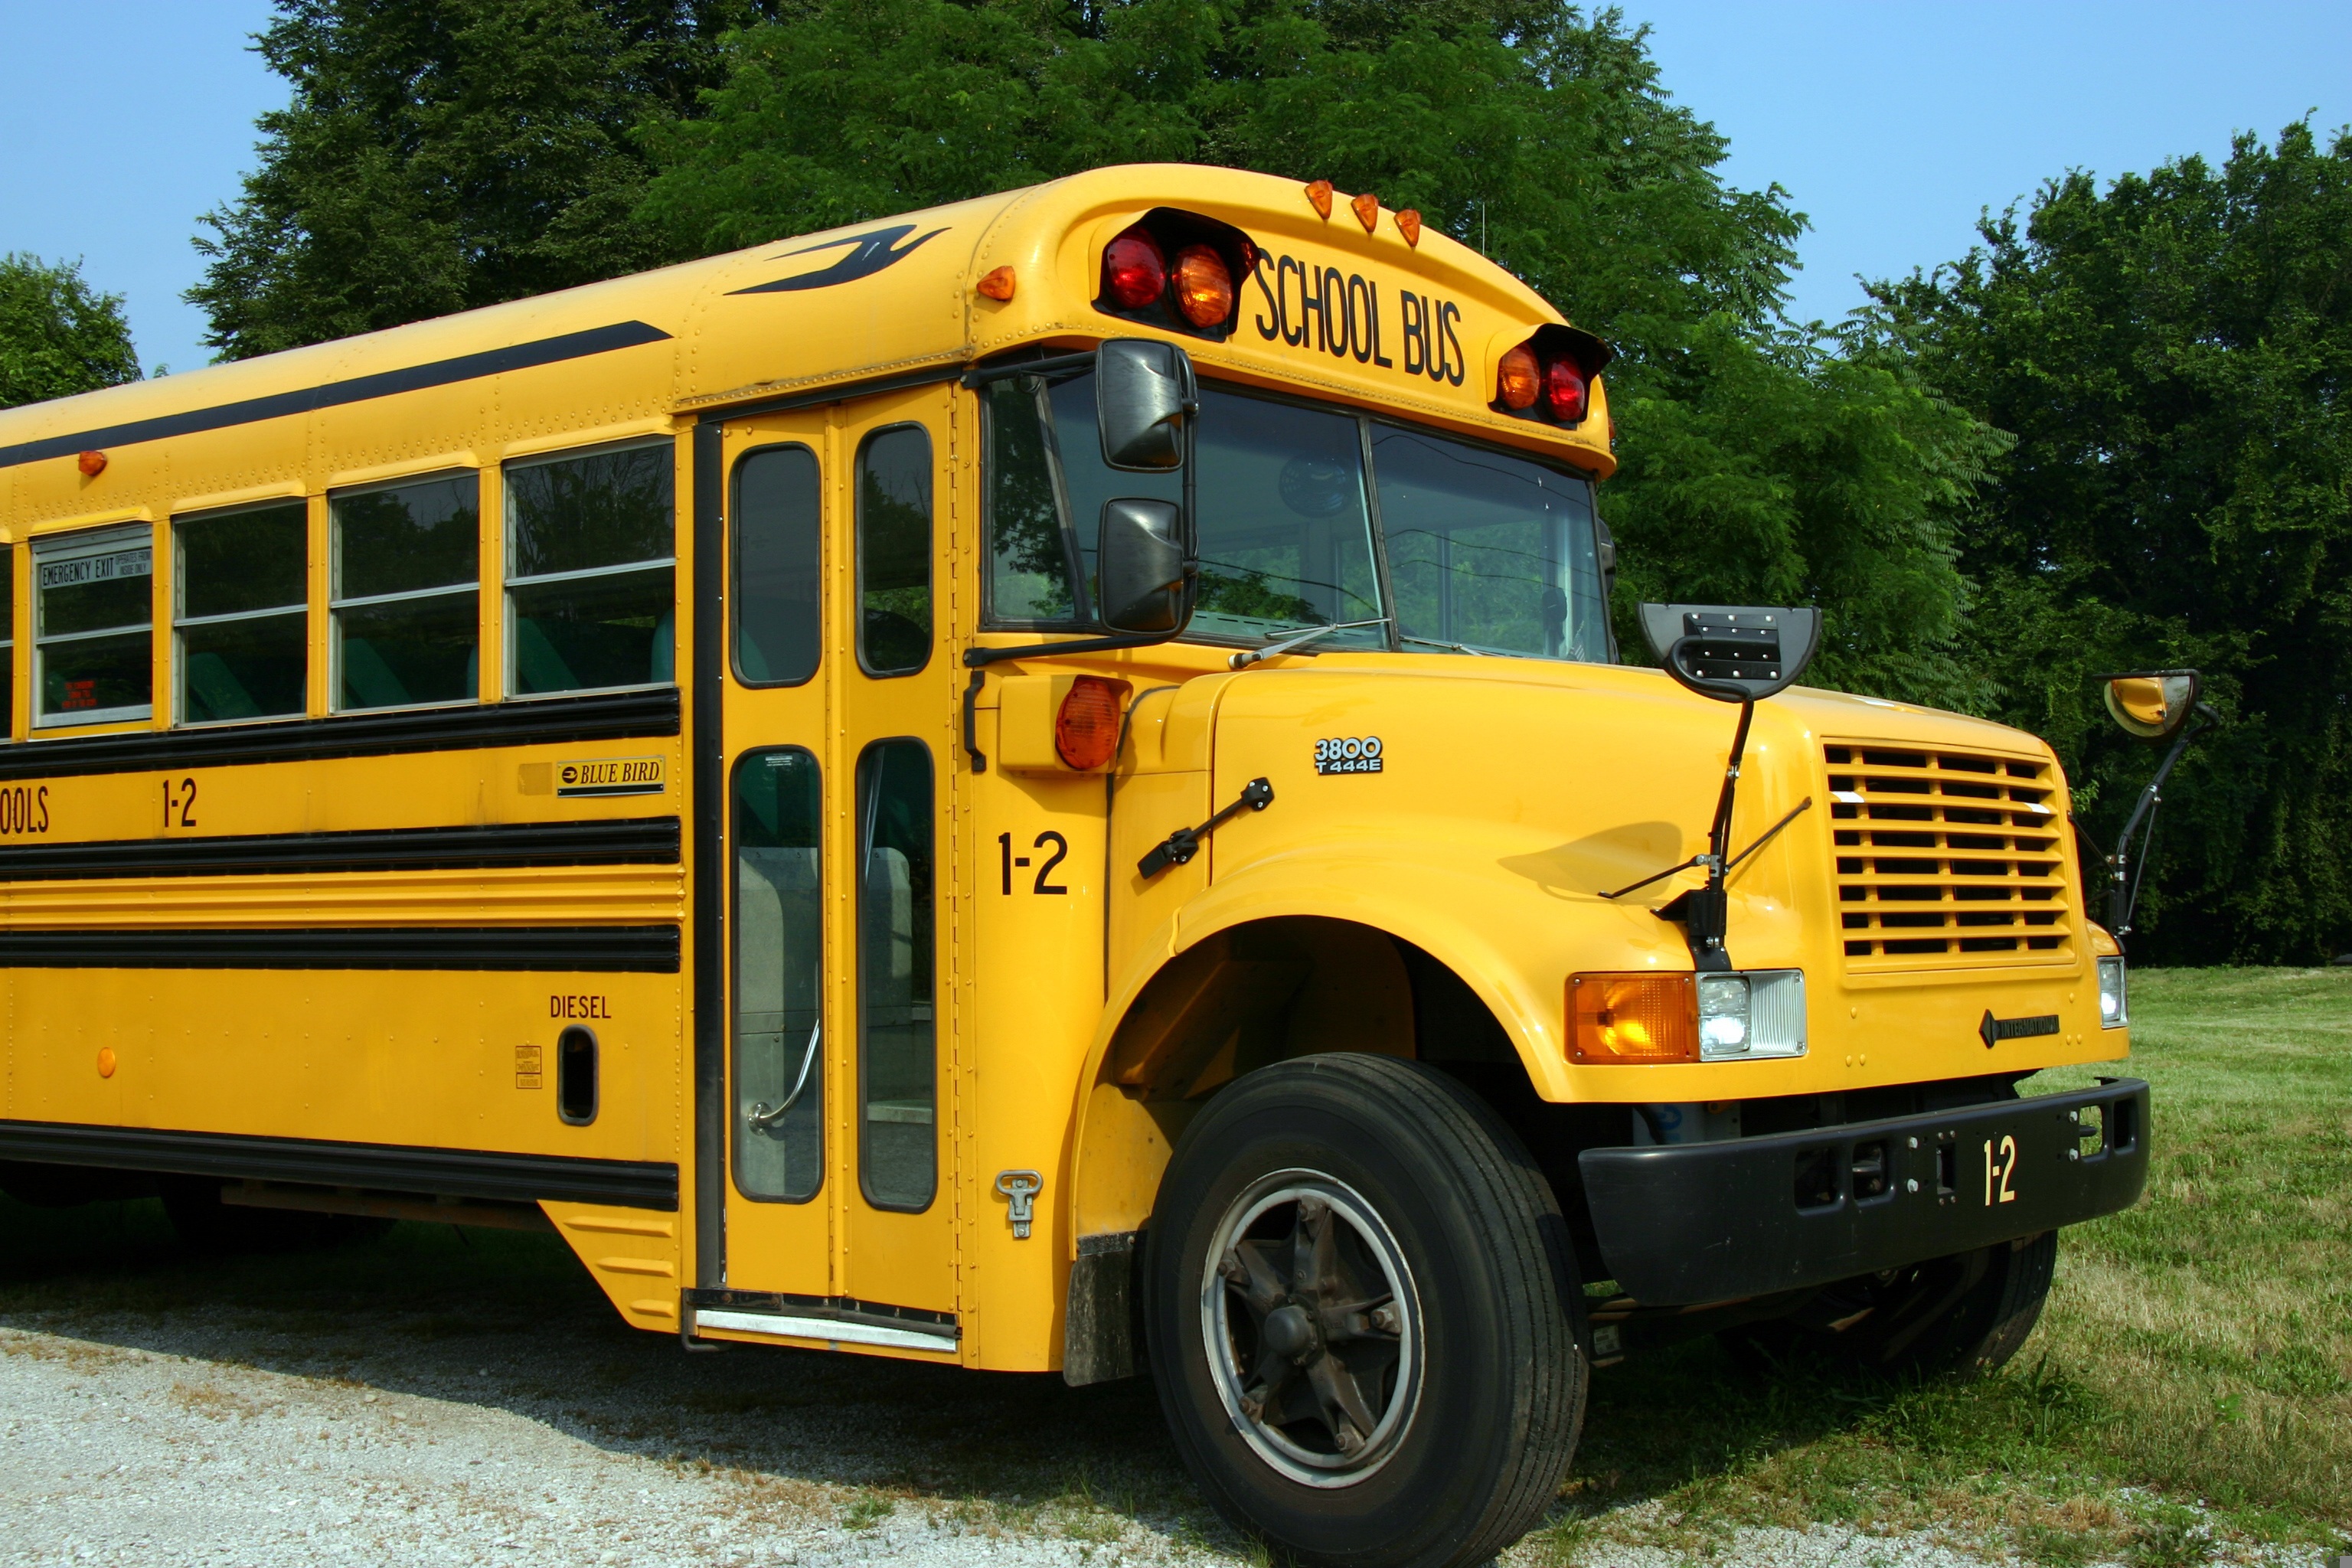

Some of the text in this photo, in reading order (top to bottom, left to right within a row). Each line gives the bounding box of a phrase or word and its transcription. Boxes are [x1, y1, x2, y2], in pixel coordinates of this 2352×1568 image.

[1253, 247, 1465, 387] SCHOOL BUS
[43, 557, 114, 586] EMERGENCY EXIT
[1315, 736, 1382, 761] 3800
[580, 761, 659, 785] BLUE BIRD
[1315, 758, 1382, 774] T 444E
[163, 777, 197, 828] 1-2
[998, 830, 1068, 895] 1-2
[550, 995, 612, 1019] DIESEL
[2001, 1015, 2058, 1038] INTERNATIONAL
[1984, 1134, 2017, 1207] 1-2
